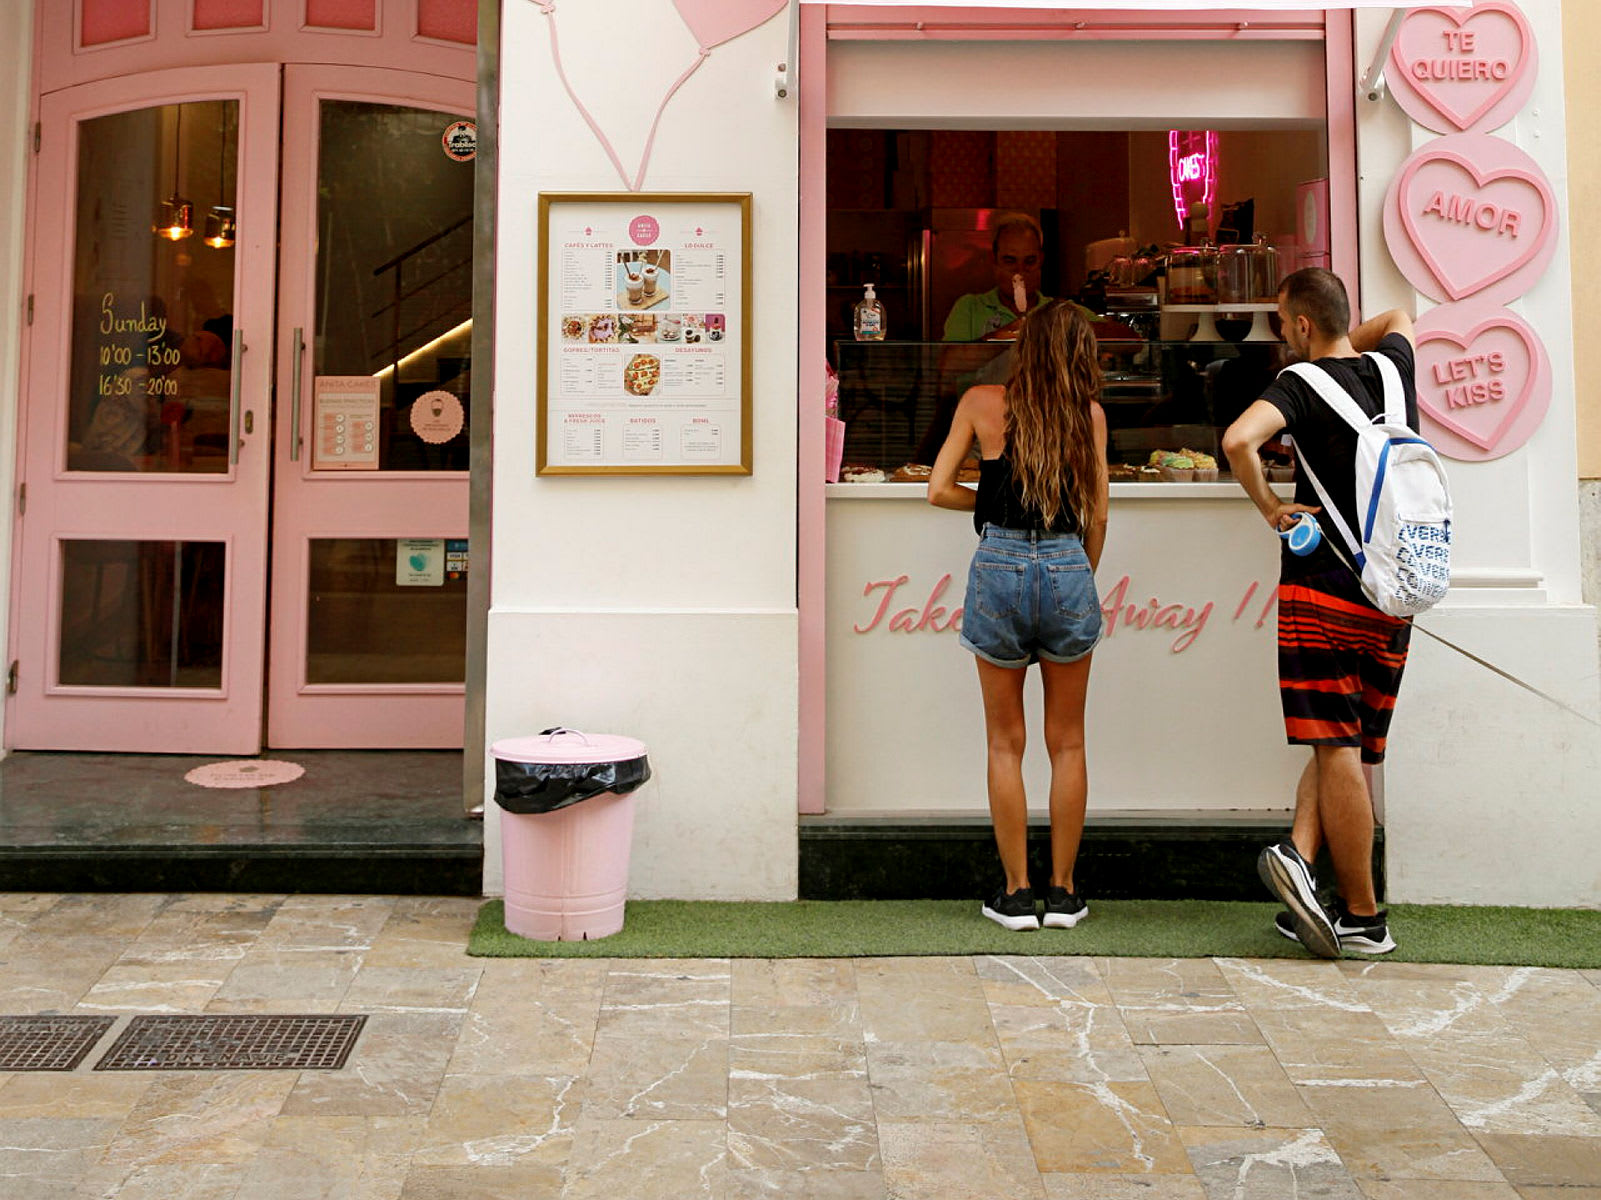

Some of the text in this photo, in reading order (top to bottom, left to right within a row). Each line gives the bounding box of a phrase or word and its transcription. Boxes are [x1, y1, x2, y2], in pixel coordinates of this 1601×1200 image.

[1443, 30, 1475, 52] TE
[1411, 58, 1511, 81] QUIERO
[1423, 190, 1522, 238] AMOR
[100, 292, 167, 342] Sunday
[1432, 352, 1506, 385] LET'S
[1445, 381, 1506, 409] KISS
[1100, 575, 1214, 654] Away
